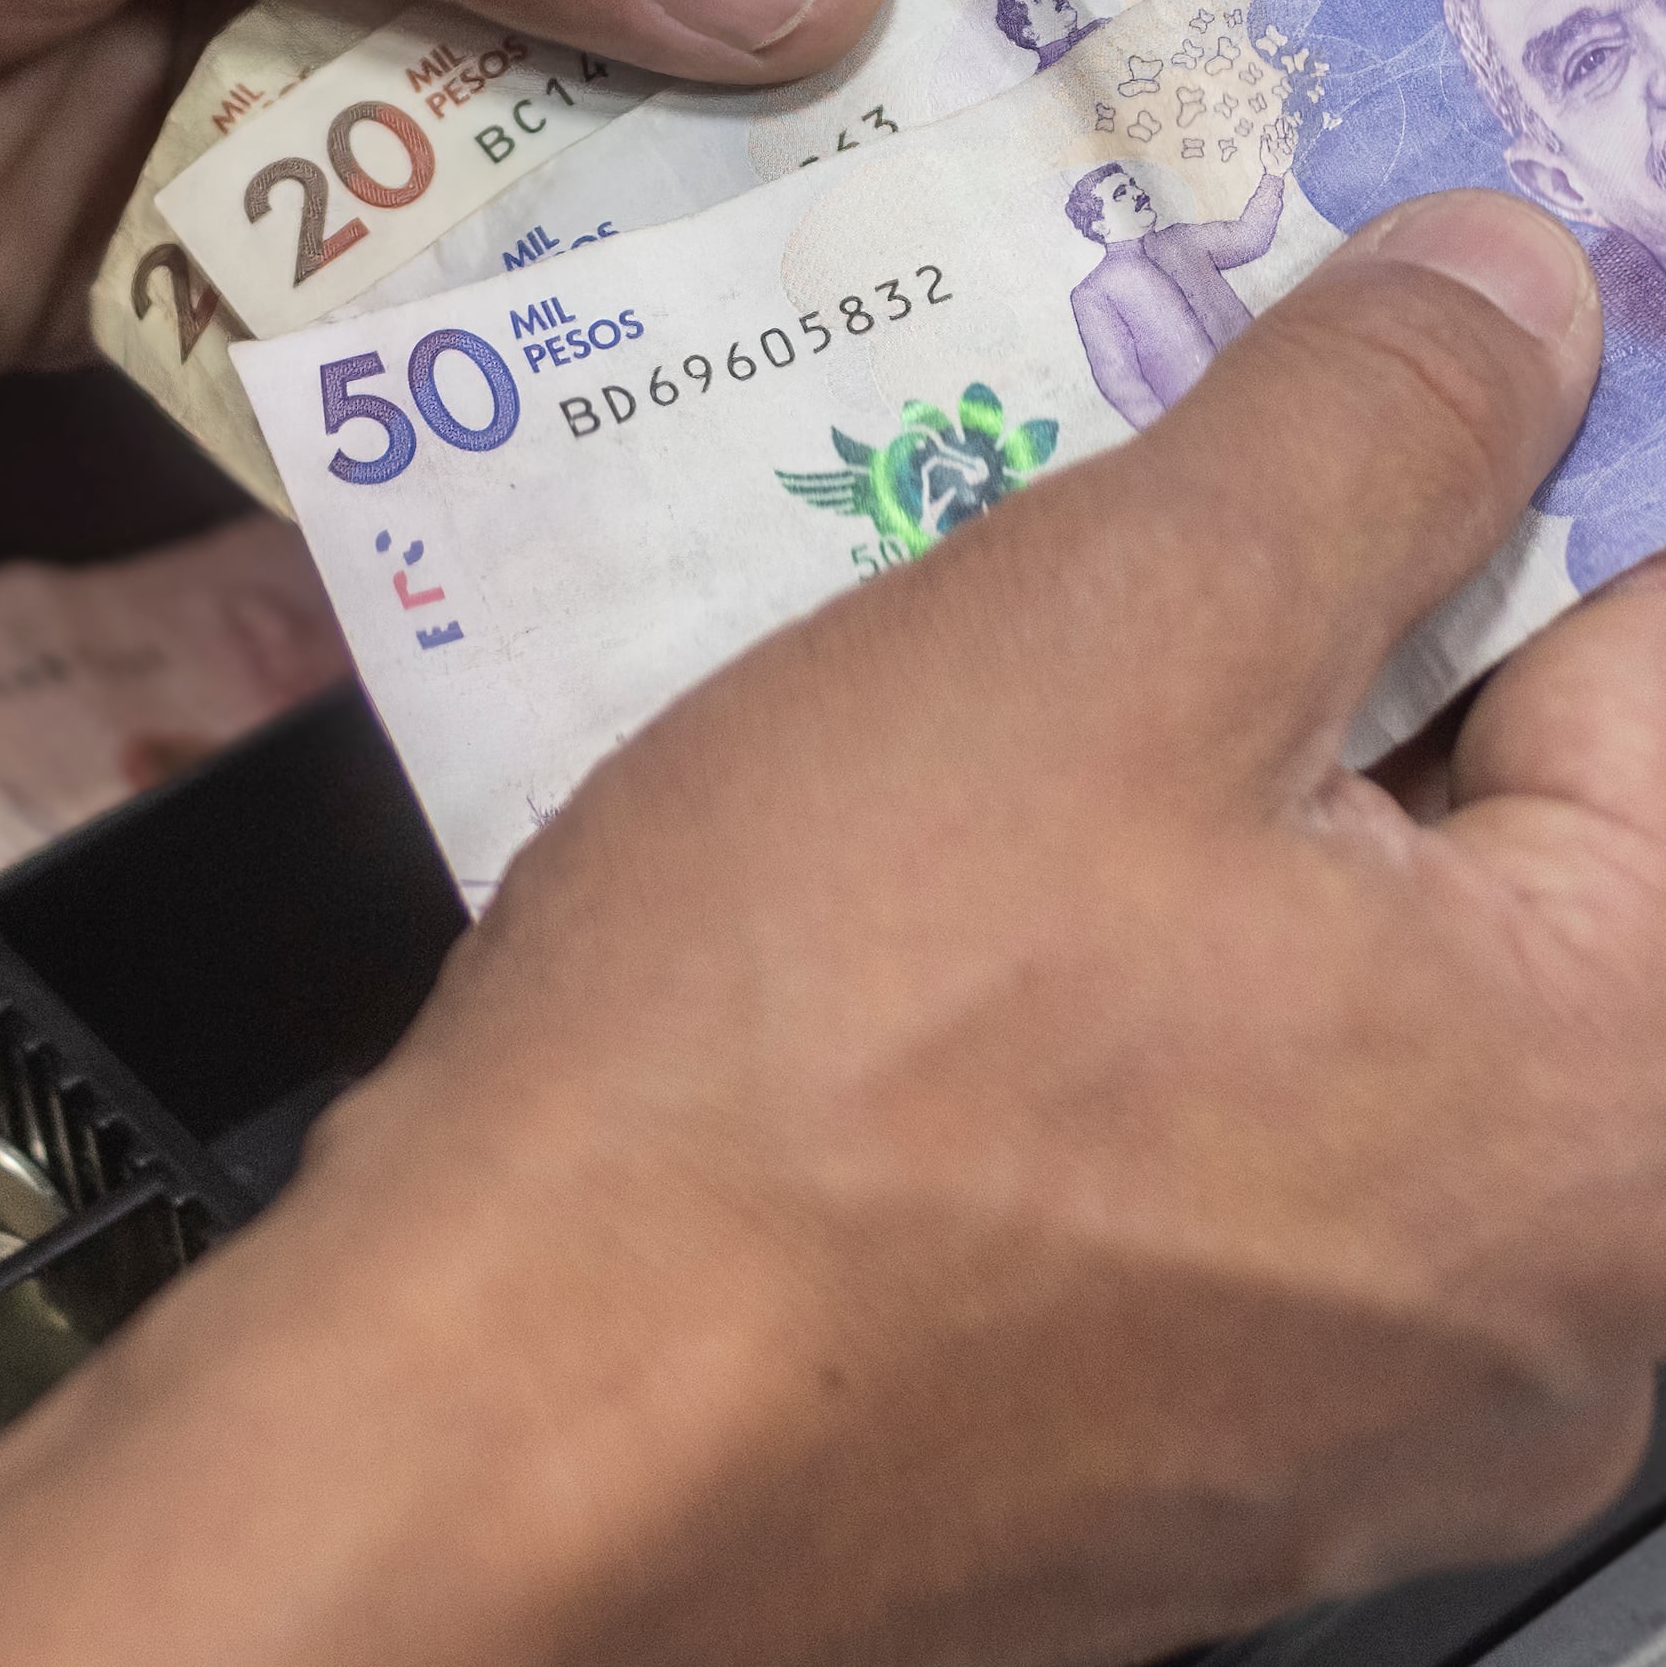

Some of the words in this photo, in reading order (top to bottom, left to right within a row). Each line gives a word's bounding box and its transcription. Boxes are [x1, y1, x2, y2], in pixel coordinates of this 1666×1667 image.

[405, 43, 467, 94] MIL
[426, 35, 528, 120] PESOS
[211, 82, 265, 134] MIL
[244, 100, 435, 289] 20
[501, 224, 561, 272] MIL
[509, 296, 576, 339] MIL
[523, 309, 645, 373] PESOS
[559, 264, 953, 440] BD69605832
[320, 328, 520, 486] 50
